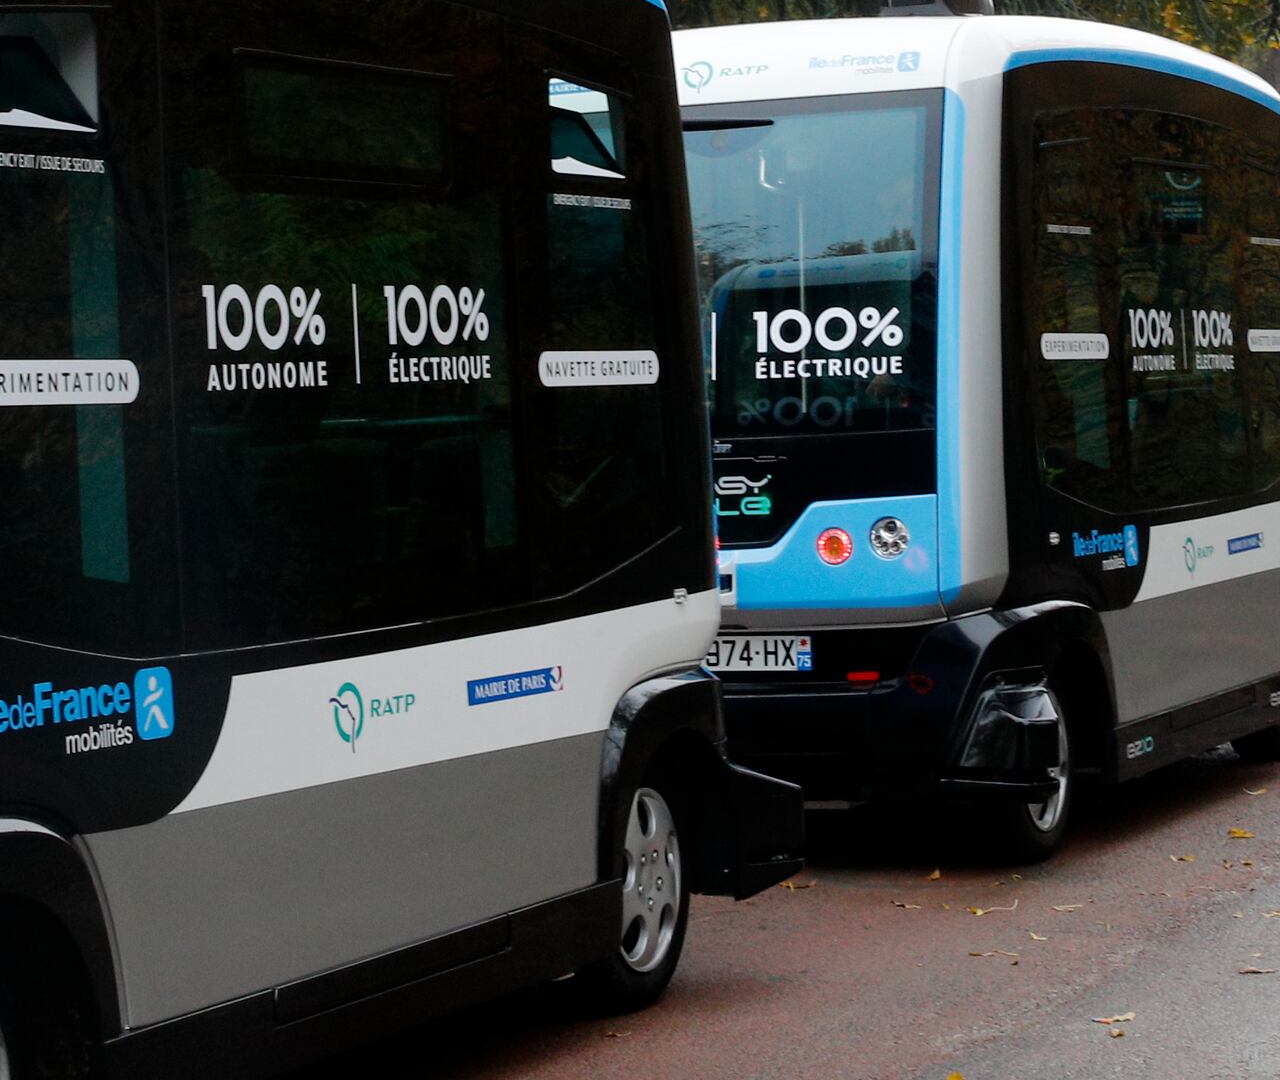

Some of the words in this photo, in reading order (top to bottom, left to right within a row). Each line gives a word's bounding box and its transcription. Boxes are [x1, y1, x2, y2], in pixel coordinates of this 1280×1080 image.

[719, 65, 768, 77] RATP
[202, 284, 326, 351] 100%
[383, 284, 490, 346] 100%
[753, 306, 904, 353] 100%
[1128, 308, 1174, 349] 100%
[1191, 309, 1234, 348] 100%
[207, 361, 328, 391] AUTONOME
[388, 352, 492, 384] ÉLECTRIQUE
[545, 361, 596, 377] NAVETTE
[600, 360, 653, 376] GRATUITE
[755, 356, 904, 379] ÉLECTRIQUE
[1132, 355, 1176, 372] AUTONOME
[1196, 352, 1235, 373] ÉLECTRIQUE
[714, 474, 772, 495] SY
[797, 655, 812, 668] 75
[475, 680, 507, 699] MAIRIE
[508, 678, 521, 694] DE
[522, 673, 547, 691] PARIS
[370, 694, 416, 718] RATP
[65, 720, 134, 754] mobilités
